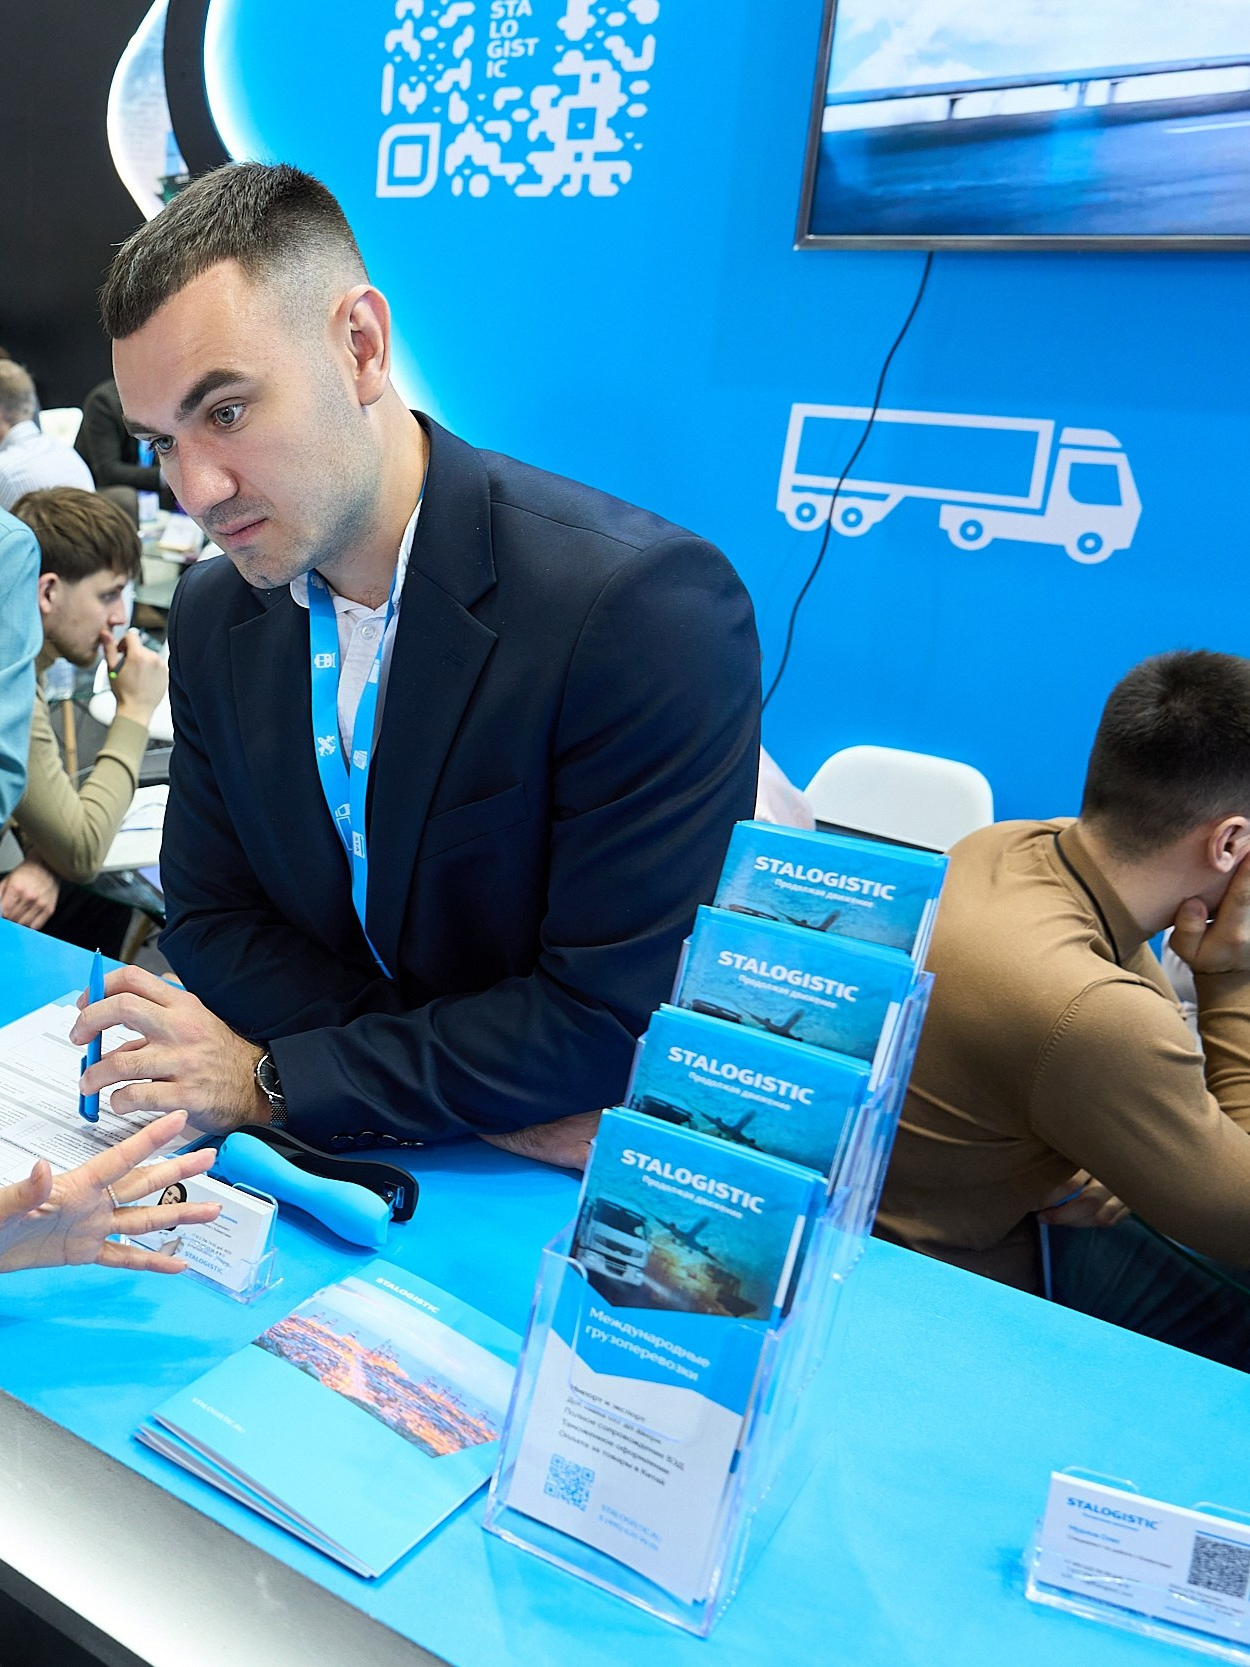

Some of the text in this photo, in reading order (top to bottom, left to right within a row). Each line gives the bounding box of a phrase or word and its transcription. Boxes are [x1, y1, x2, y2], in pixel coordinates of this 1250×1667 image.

[490, 0, 532, 19] STA
[490, 19, 519, 39] LO
[487, 37, 540, 59] GIST
[486, 59, 508, 78] IC
[753, 856, 897, 901] STALOGISTIC
[717, 950, 860, 1003] STALOGISTIC
[667, 1046, 815, 1106] STALOGISTIC
[620, 1149, 766, 1215] STALOGISTIC
[185, 1251, 223, 1275] STALOGISTIC
[375, 1277, 440, 1314] STALOGISTIC
[585, 1325, 699, 1381] грузоперевозки
[590, 1307, 710, 1367] Международные
[1066, 1497, 1159, 1531] STALOGISTIC
